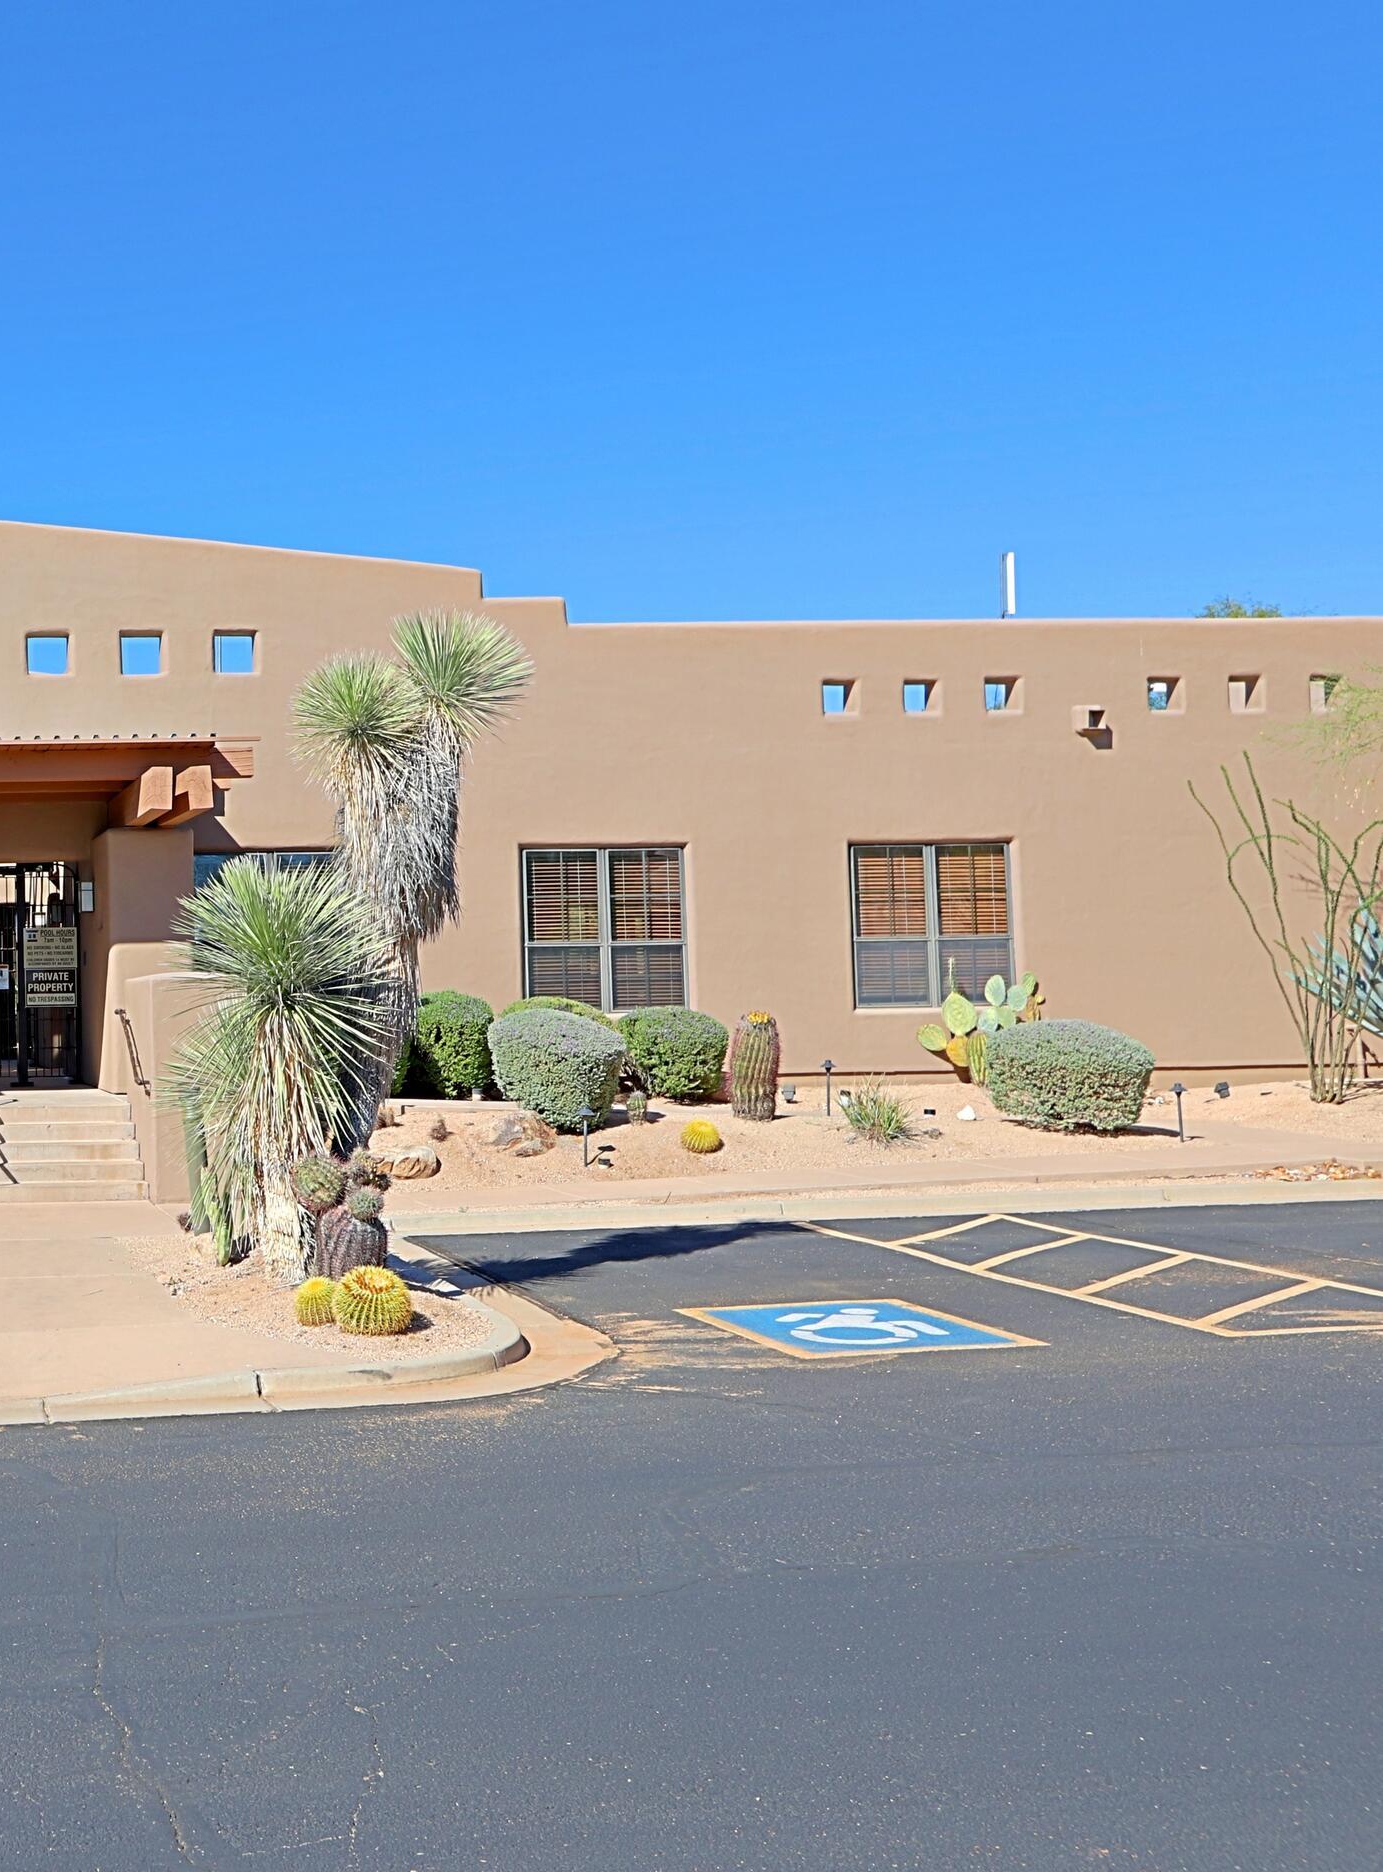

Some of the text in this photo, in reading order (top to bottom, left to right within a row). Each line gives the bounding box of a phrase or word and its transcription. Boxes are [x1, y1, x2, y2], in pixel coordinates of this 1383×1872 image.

[40, 929, 75, 937] POOL HOURS
[32, 972, 69, 981] PRIVATE
[28, 982, 73, 992] PROPERTY
